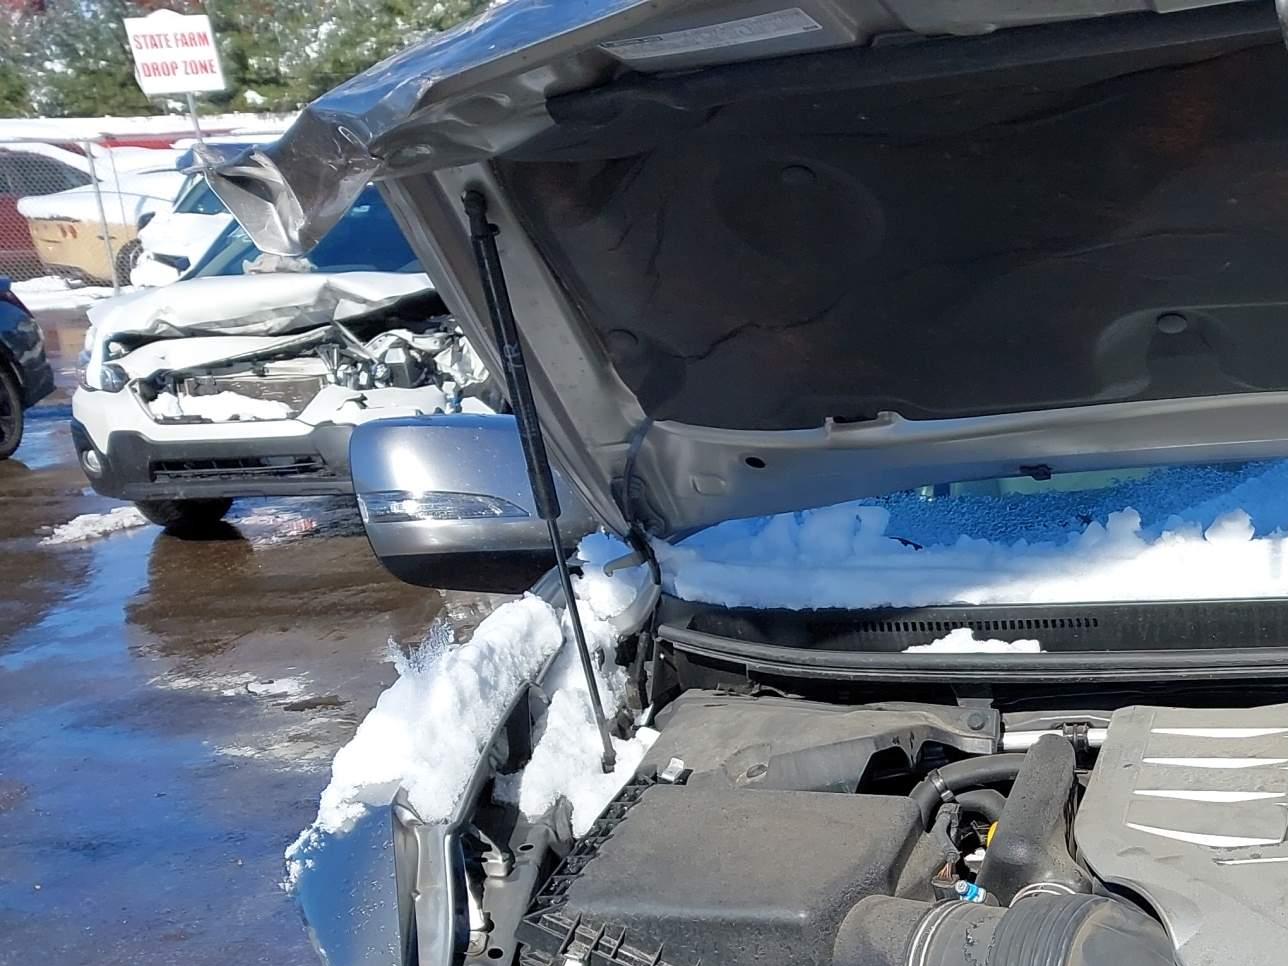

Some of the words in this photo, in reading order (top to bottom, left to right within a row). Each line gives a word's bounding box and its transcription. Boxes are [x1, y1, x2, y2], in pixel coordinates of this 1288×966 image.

[133, 33, 173, 50] STATE
[174, 31, 210, 49] FARM
[141, 61, 178, 78] DROP
[182, 59, 217, 76] ZONE
